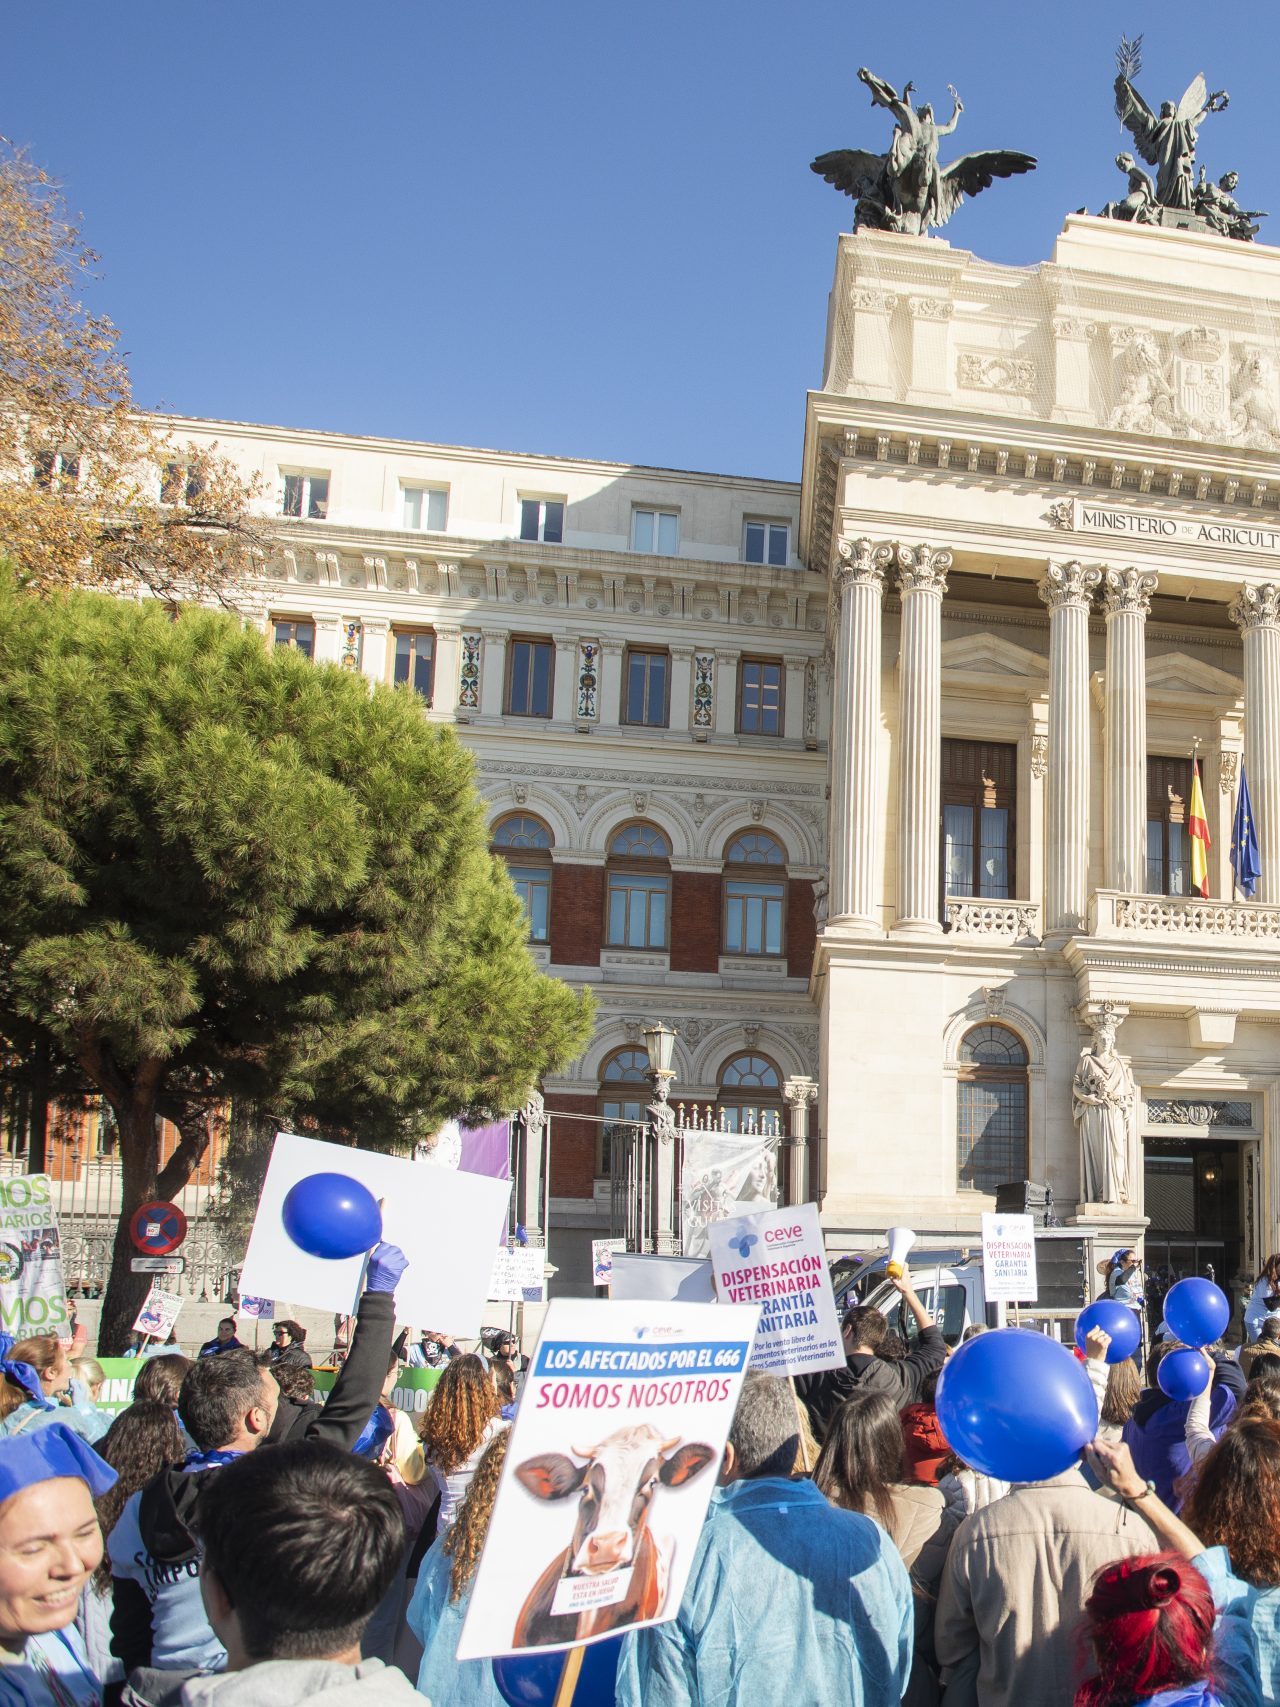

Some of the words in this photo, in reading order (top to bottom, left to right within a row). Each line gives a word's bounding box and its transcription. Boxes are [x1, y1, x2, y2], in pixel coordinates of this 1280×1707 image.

[1083, 510, 1176, 535] MINISTERIO
[1181, 525, 1193, 534] DE
[764, 1225, 802, 1243] ceve
[987, 1241, 1032, 1250] DISPENSACIÓN
[721, 1254, 822, 1288] DISPENSACIÓN
[994, 1269, 1028, 1277] SANITARIA
[728, 1273, 821, 1303] VETERINARIA
[754, 1290, 815, 1315] RANTÍA
[758, 1309, 818, 1334] NITARIA
[750, 1350, 780, 1361] camentos
[780, 1343, 818, 1355] veterinarios
[828, 1339, 837, 1347] los
[754, 1343, 765, 1351] Por
[772, 1338, 790, 1347] venta
[791, 1336, 806, 1344] libre
[806, 1333, 815, 1341] de
[544, 1349, 577, 1369] LOS
[578, 1350, 669, 1371] AFECTADOS
[669, 1350, 698, 1369] POR
[697, 1350, 712, 1367] EL
[714, 1349, 741, 1366] 666
[765, 1356, 797, 1368] Sanitarios
[797, 1349, 835, 1362] Veterinarios
[536, 1383, 623, 1409] SOMOS
[627, 1378, 731, 1409] NOSOTROS
